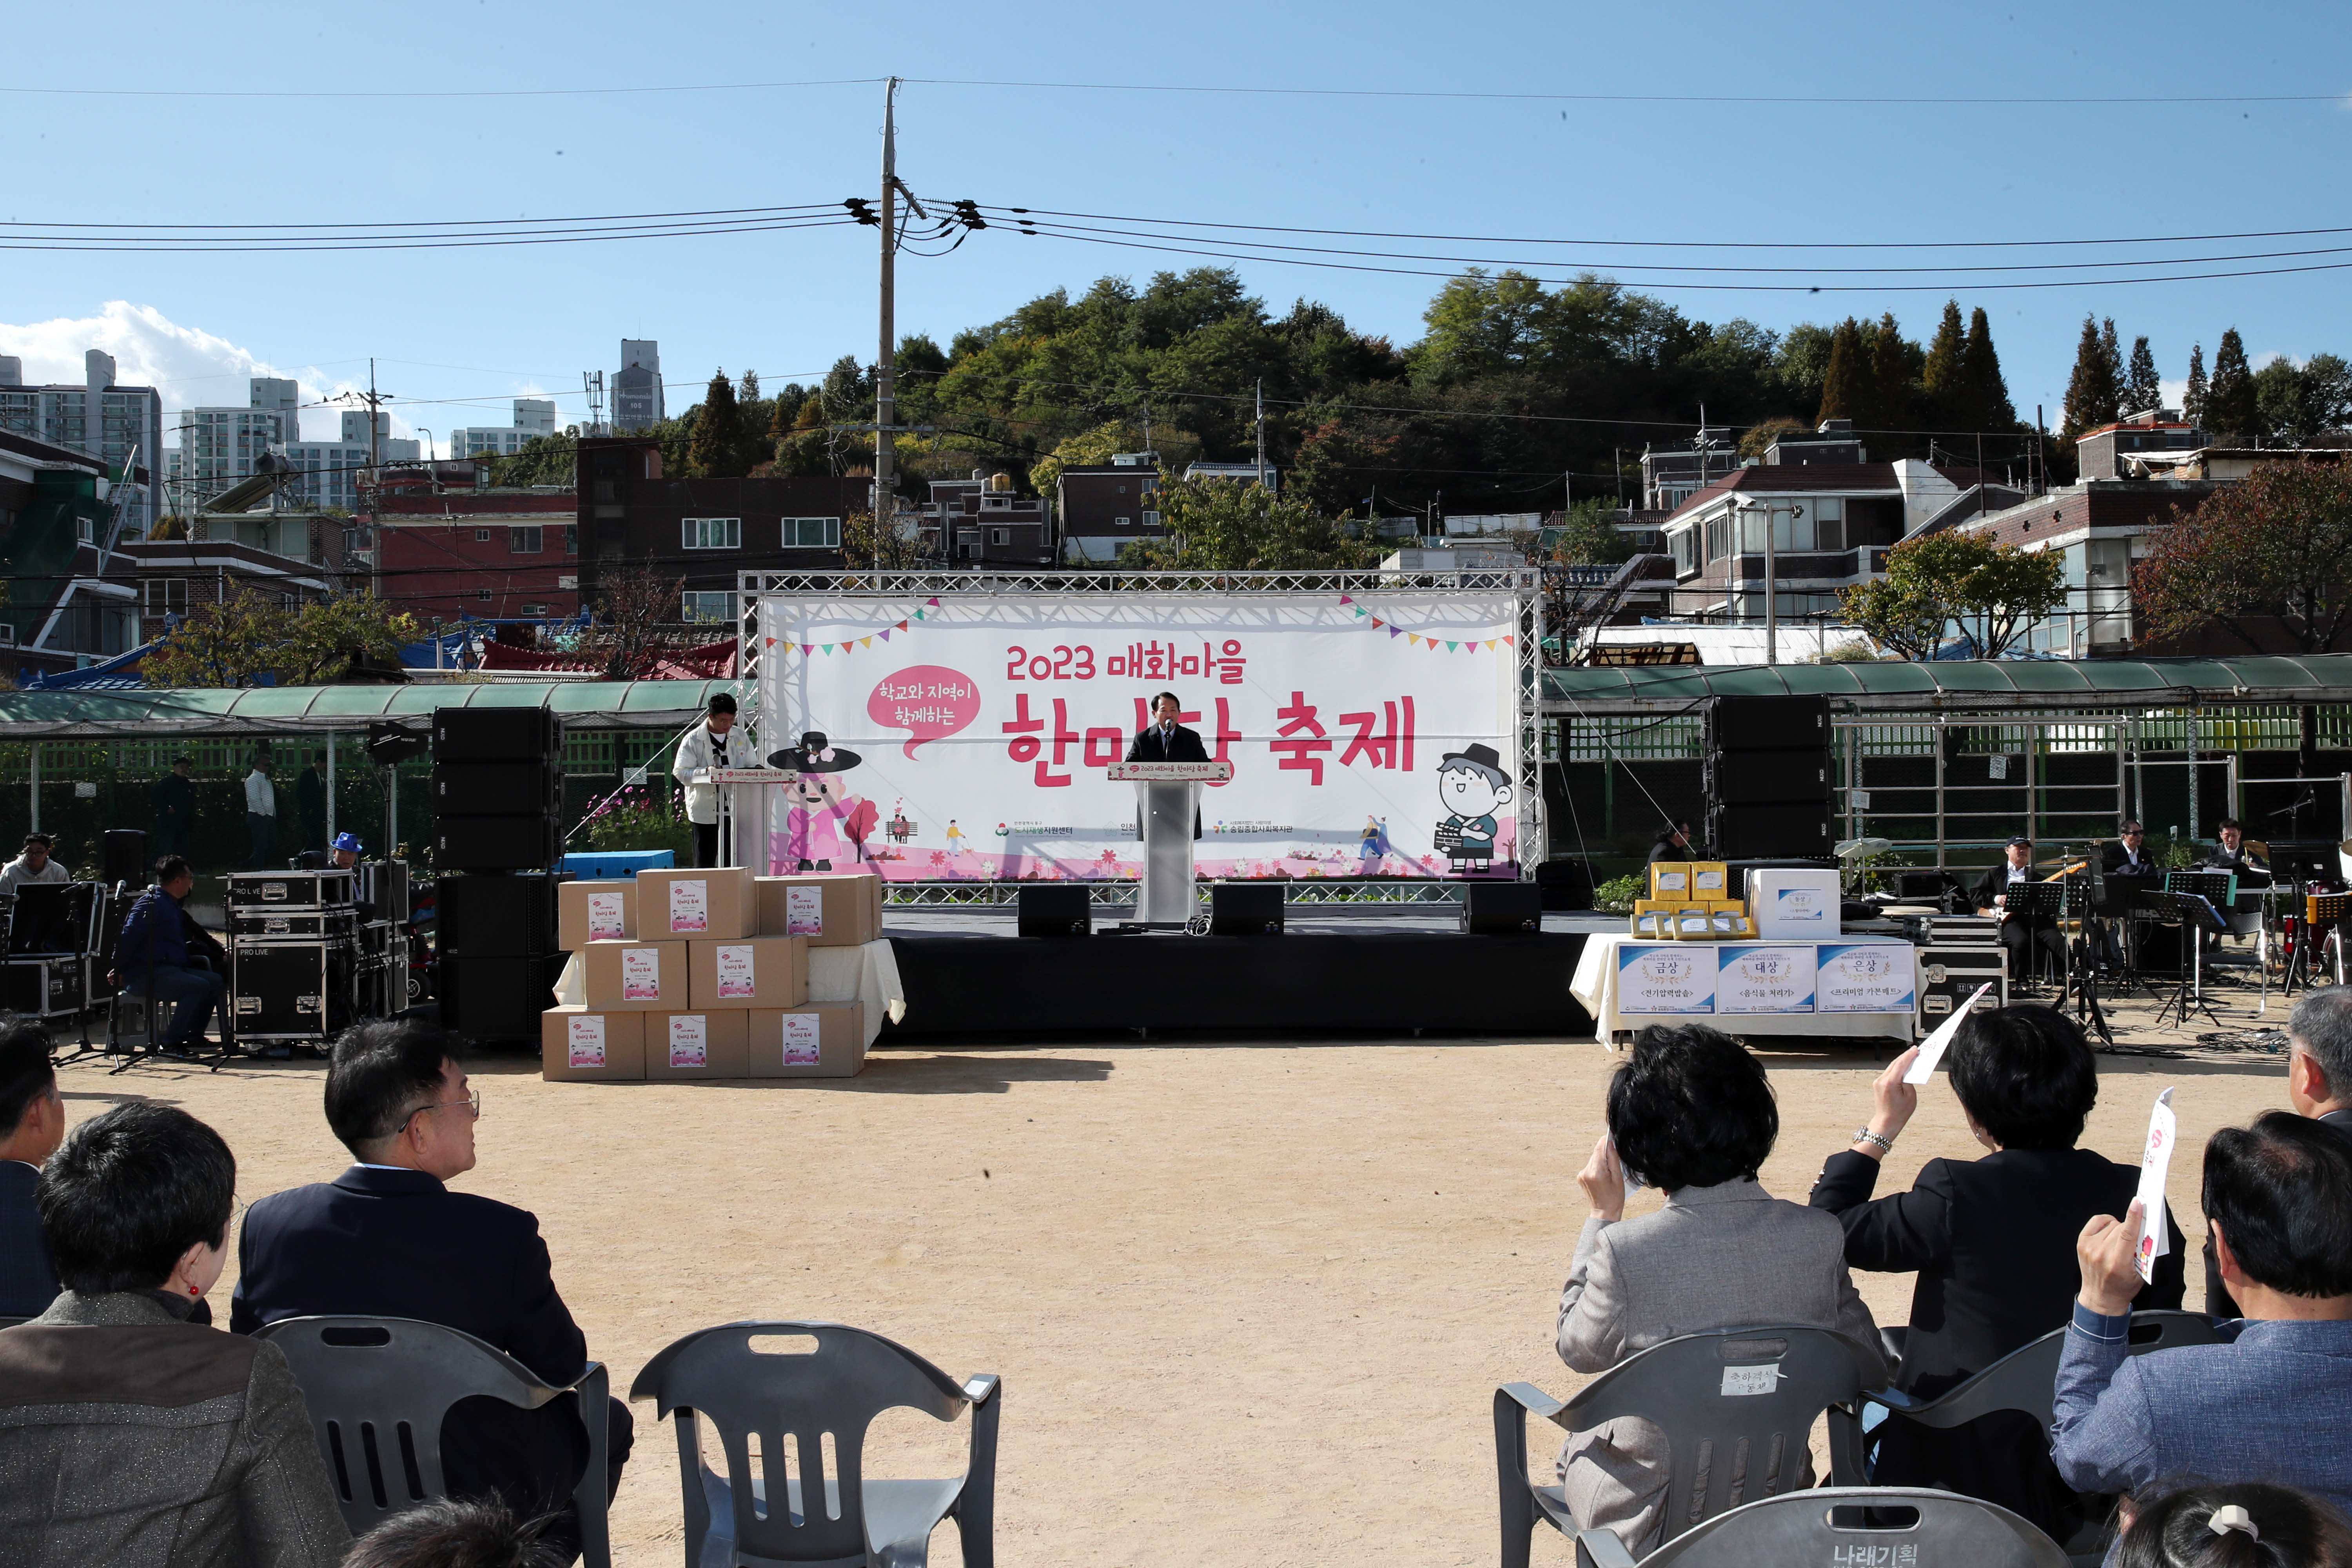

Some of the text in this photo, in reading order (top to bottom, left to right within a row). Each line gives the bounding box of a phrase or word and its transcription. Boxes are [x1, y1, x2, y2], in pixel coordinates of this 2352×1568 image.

[1007, 639, 1247, 684] 2023 매화마을
[879, 682, 971, 702] 학교와 지역이
[895, 706, 956, 726] 함께하는
[1270, 691, 1415, 786] 축제
[1014, 826, 1073, 835] 도시재생지원센터
[1230, 825, 1293, 833] 송림종합사회복지관
[1655, 962, 1679, 974] 금상
[1755, 961, 1779, 974] 대상
[1853, 960, 1877, 972] 은상
[1641, 989, 1693, 998] <전기압력밥솥>
[1739, 989, 1794, 998] <음식물 처리기>
[1830, 987, 1902, 996] <프리미엄 카본매트>
[1834, 1544, 1918, 1566] 나래기획
